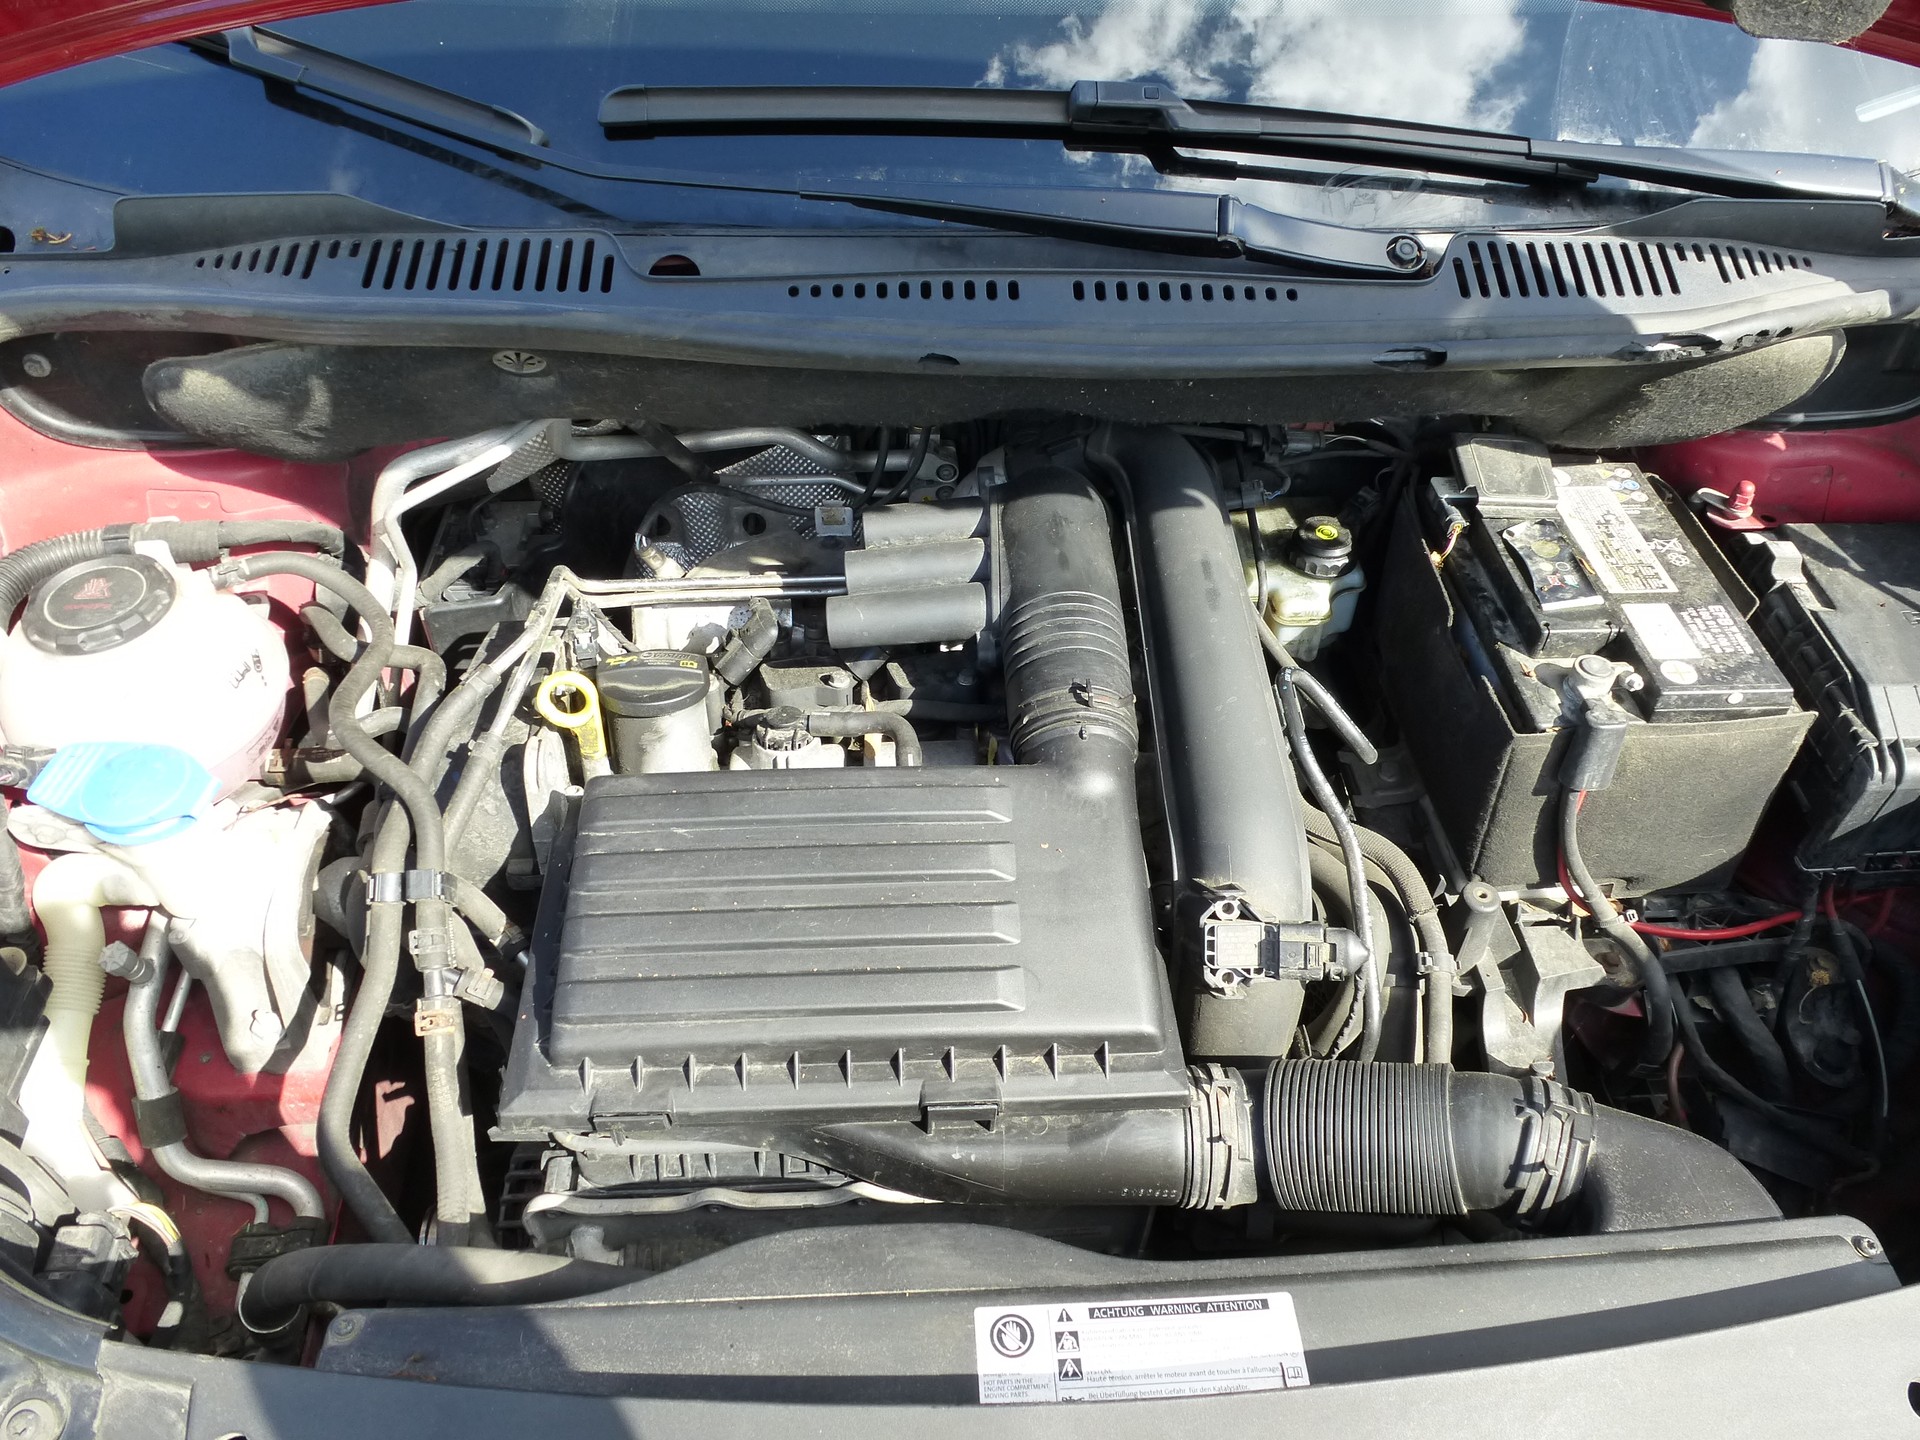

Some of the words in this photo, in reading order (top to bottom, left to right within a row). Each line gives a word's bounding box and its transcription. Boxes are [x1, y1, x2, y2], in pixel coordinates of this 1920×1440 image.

[1708, 605, 1734, 625] EFB
[1093, 1306, 1144, 1319] ACHTUNG
[1150, 1303, 1200, 1316] WARNING
[1206, 1300, 1262, 1312] ATTENTION
[1139, 1389, 1163, 1397] besteht
[1164, 1387, 1186, 1395] Gefahr
